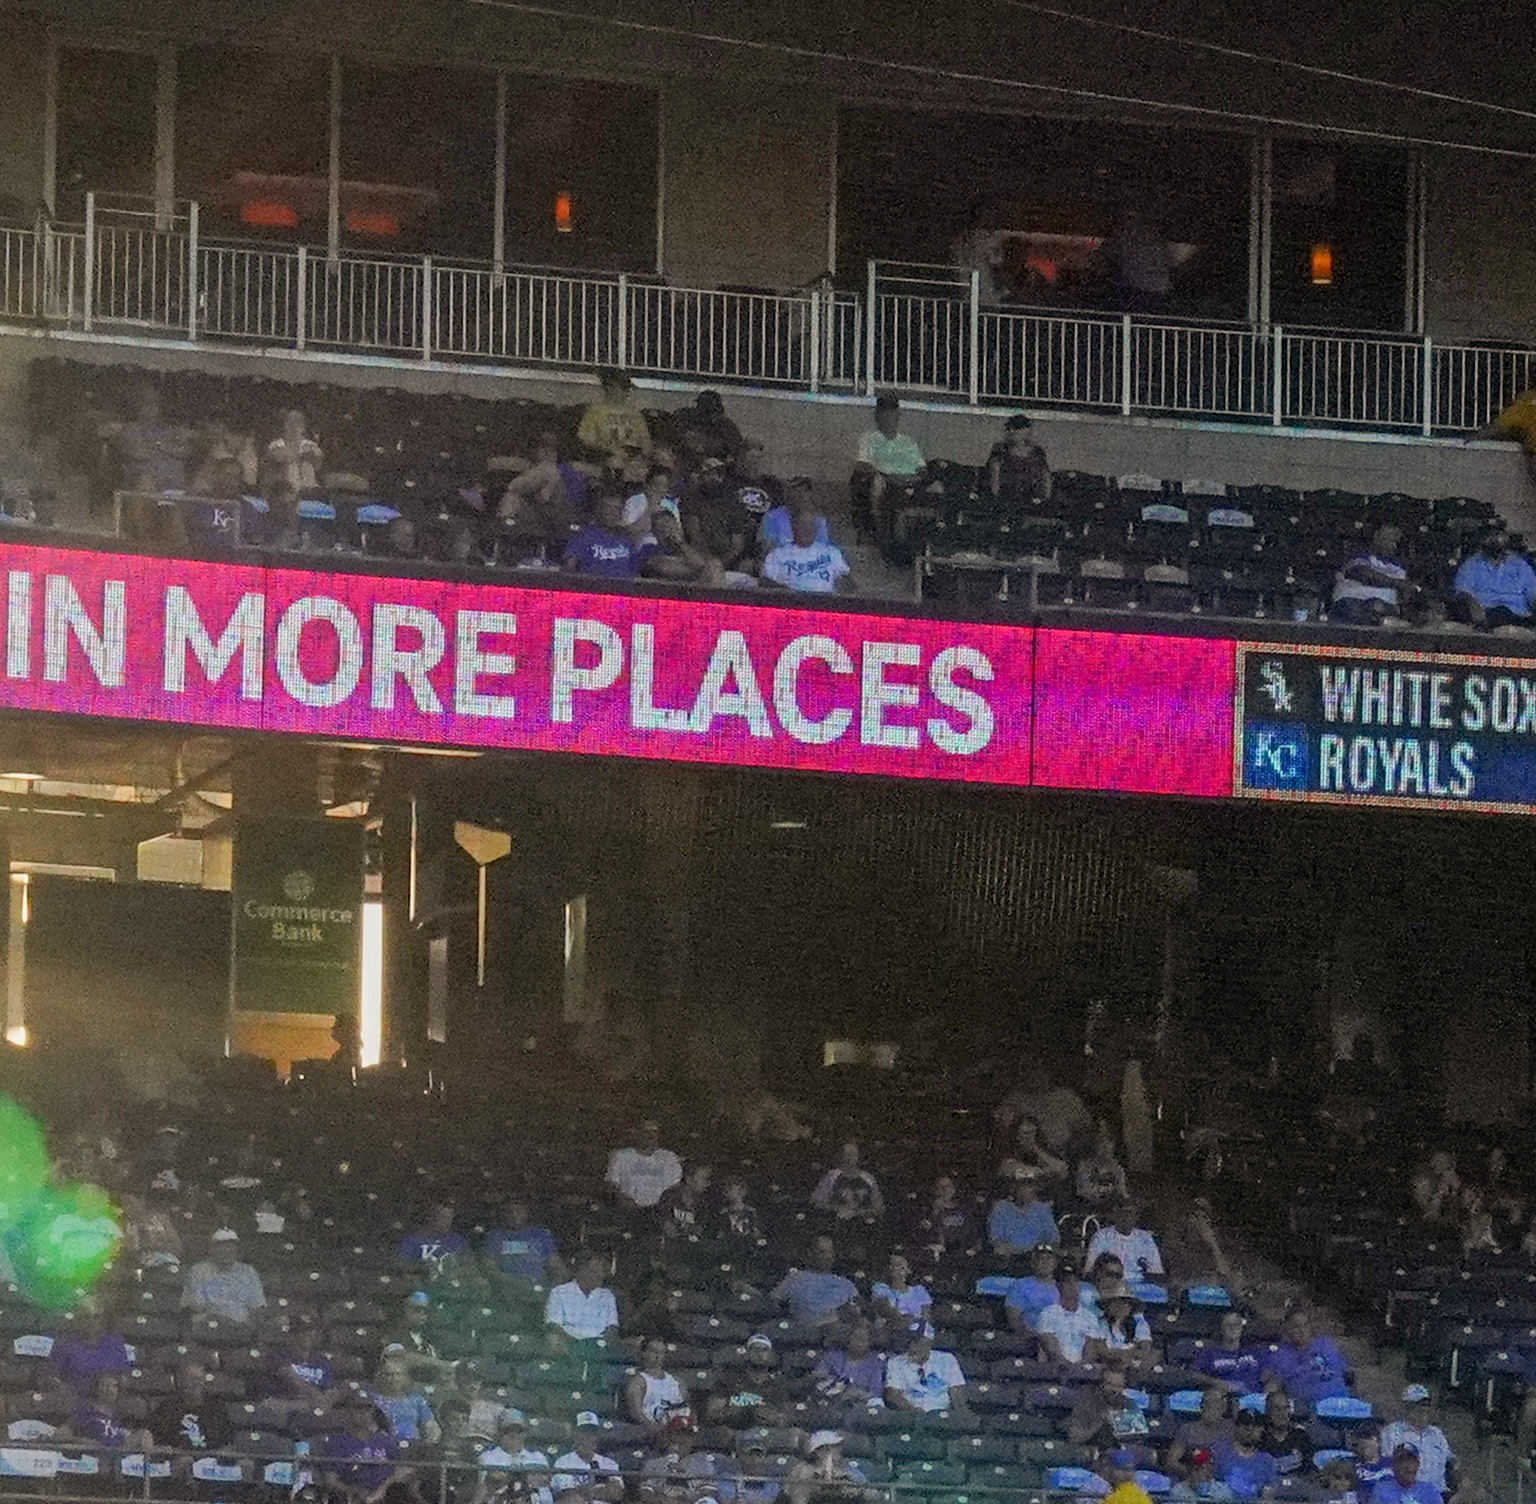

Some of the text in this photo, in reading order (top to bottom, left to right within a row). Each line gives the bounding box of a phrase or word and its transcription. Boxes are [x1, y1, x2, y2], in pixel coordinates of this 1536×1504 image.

[6, 570, 125, 691] IN
[165, 585, 515, 722] MORE
[551, 616, 996, 756] PLACES
[1321, 664, 1453, 729] WHITE
[1319, 732, 1475, 797] ROYALS
[242, 898, 354, 925] Commerce
[271, 921, 324, 942] Bank
